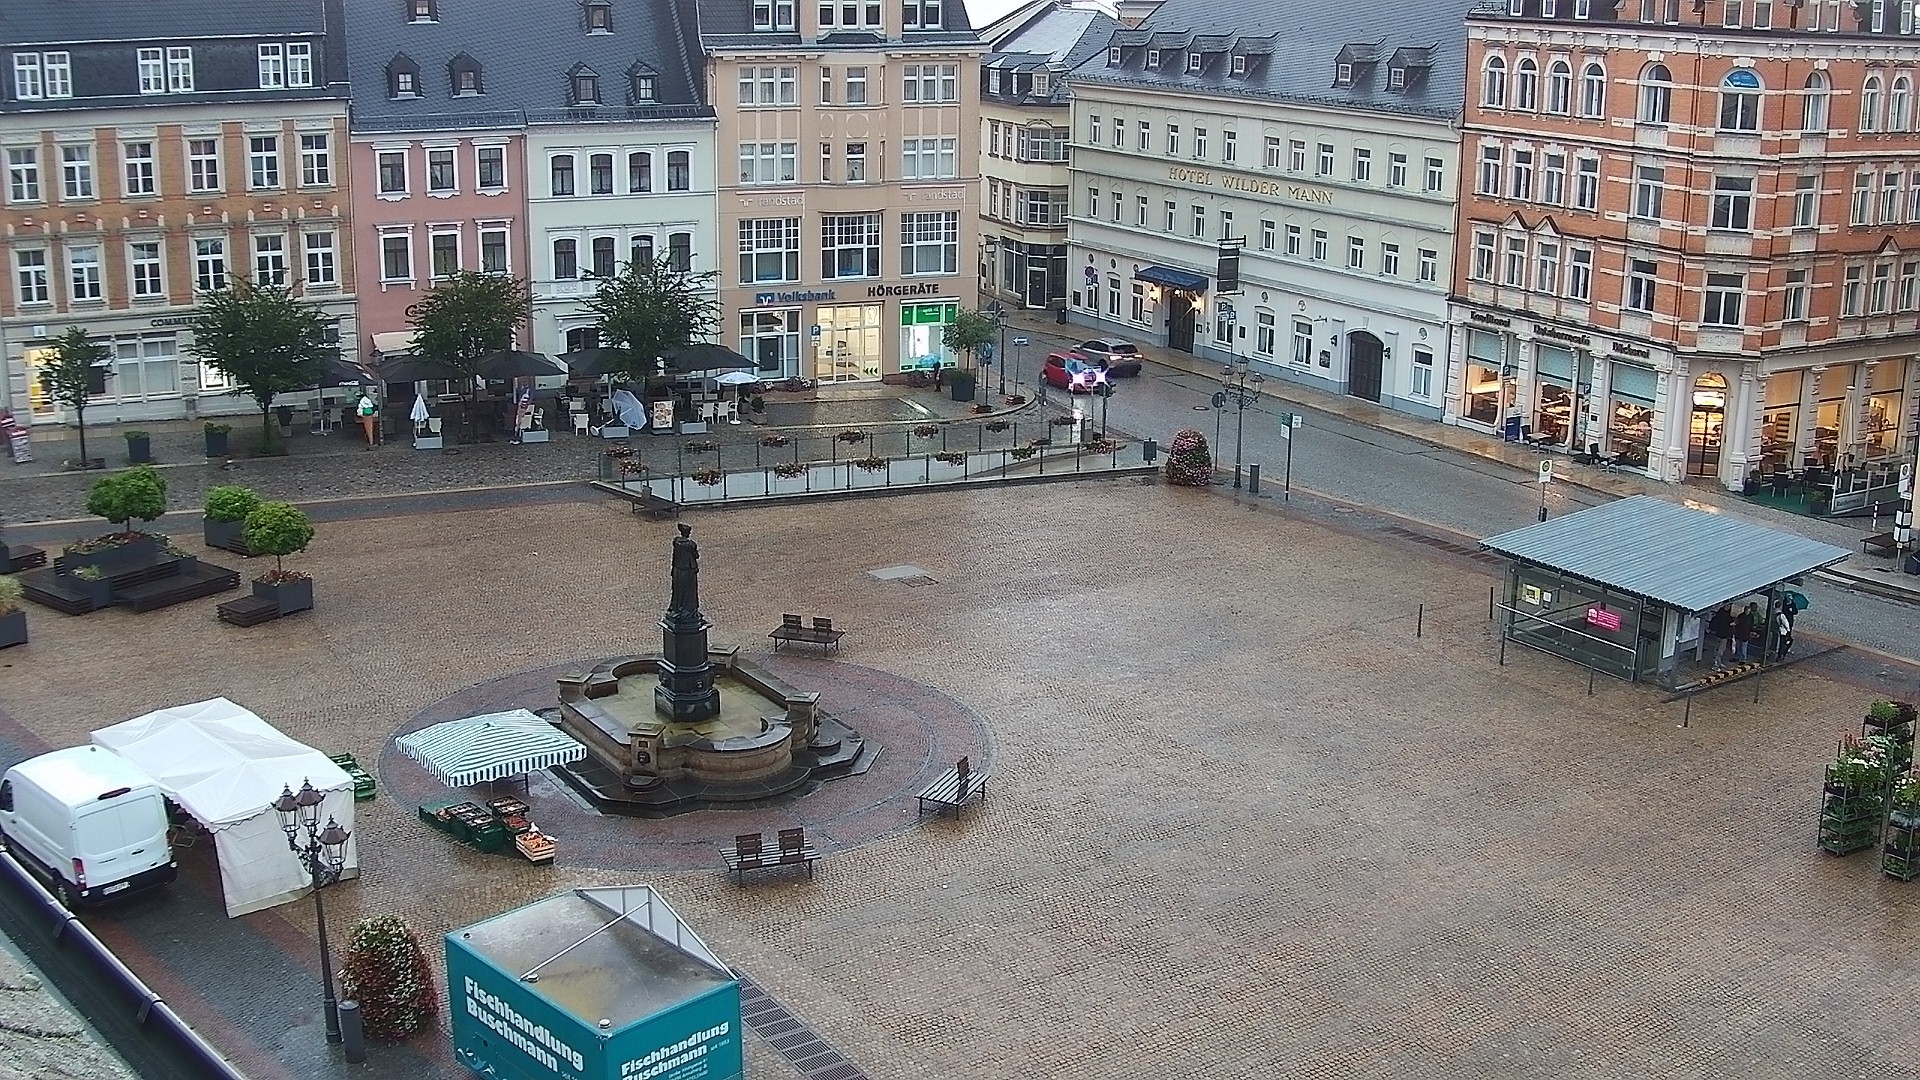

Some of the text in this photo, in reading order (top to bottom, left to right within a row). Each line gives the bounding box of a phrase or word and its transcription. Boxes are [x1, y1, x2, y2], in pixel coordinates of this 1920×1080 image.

[759, 194, 803, 206] randstad
[1169, 167, 1333, 205] HOTEL WILDER MANN
[777, 289, 837, 302] Volksbank
[867, 282, 939, 297] HÖRGERÄTE
[464, 975, 585, 1072] Fischhandlung
[466, 995, 558, 1073] Buschmann
[621, 1021, 730, 1077] Fischhandlung
